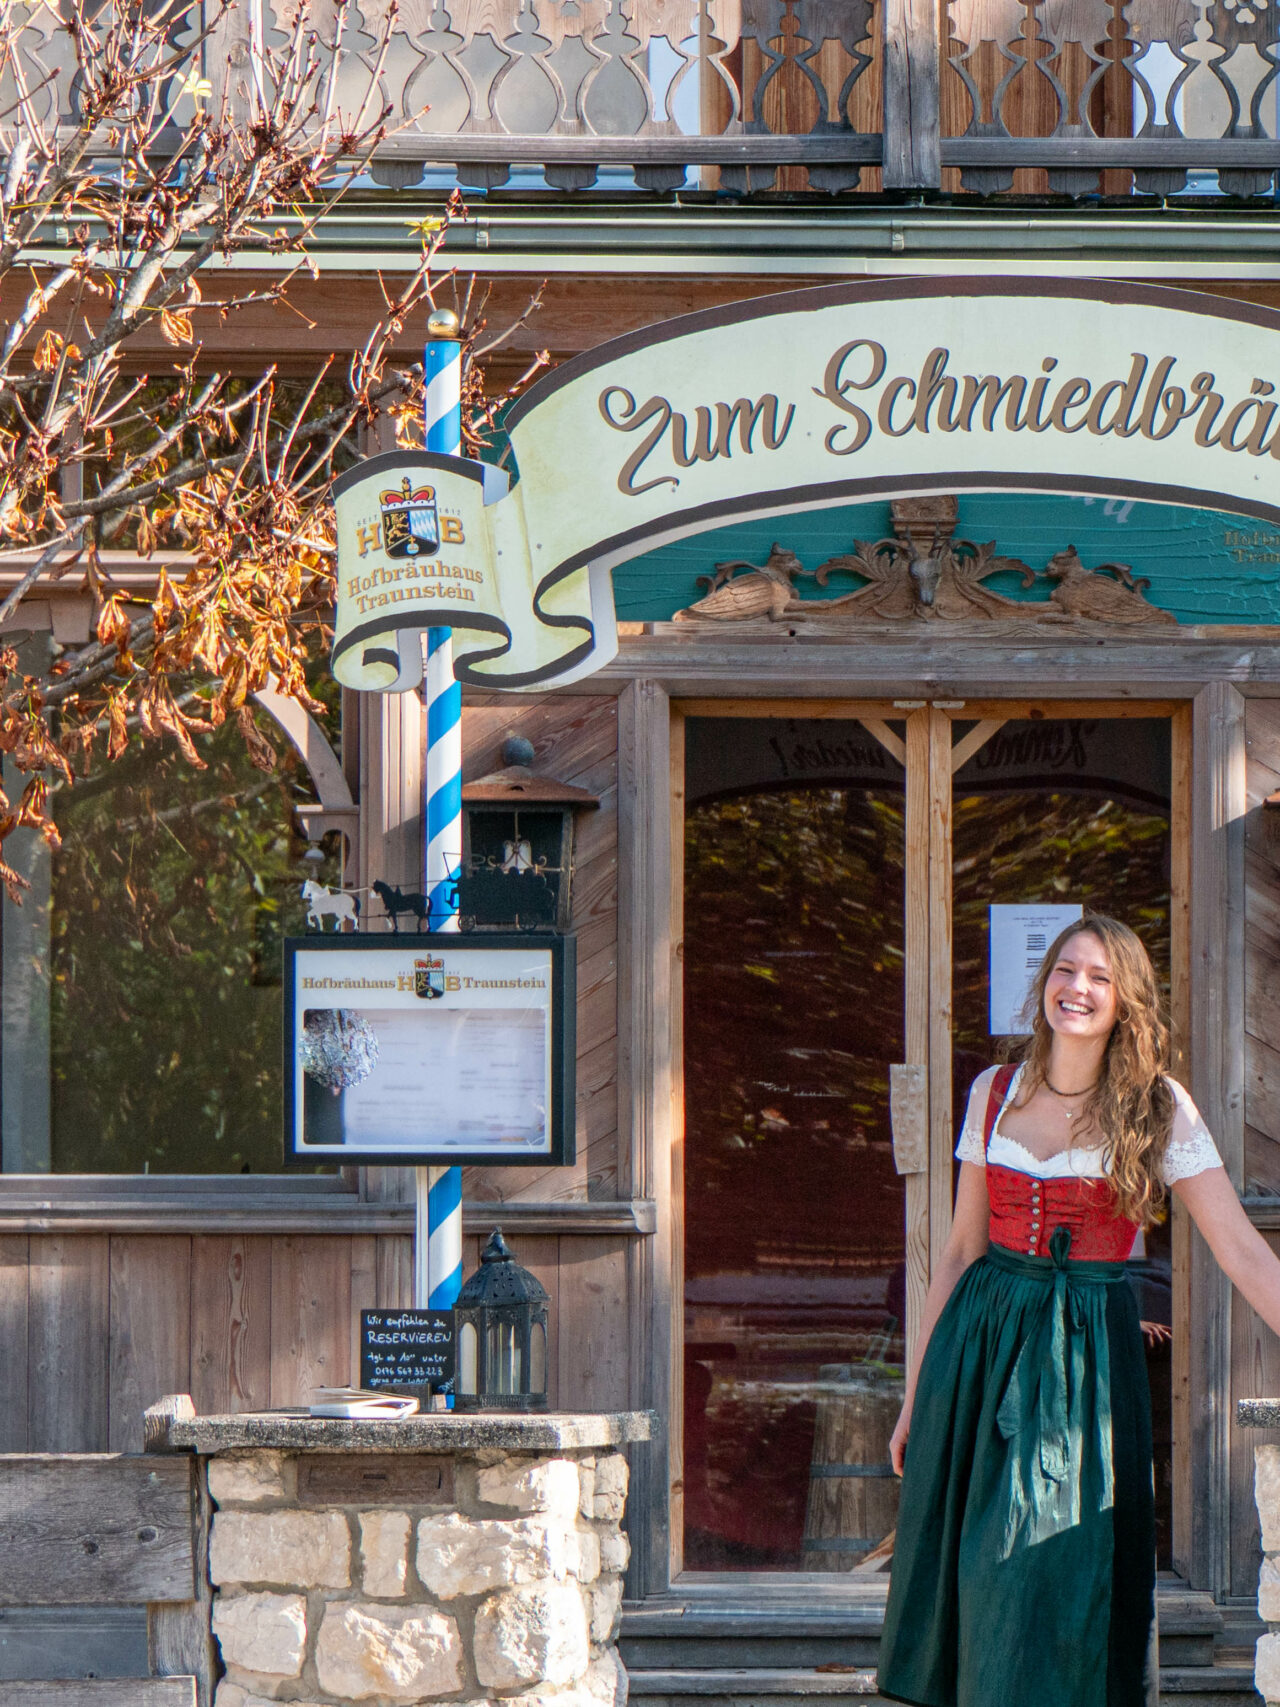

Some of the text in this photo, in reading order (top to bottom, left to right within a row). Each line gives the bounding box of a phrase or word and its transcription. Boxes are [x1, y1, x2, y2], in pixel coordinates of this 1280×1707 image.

[599, 384, 797, 496] Zum
[356, 516, 465, 557] H B
[347, 560, 483, 599] Hofbräuhaus
[356, 581, 476, 615] Traunstein
[301, 976, 396, 990] Hofbräuhaus
[463, 976, 546, 989] Traunstein
[367, 1314, 382, 1326] Wir
[386, 1313, 429, 1328] empfehlen
[422, 1354, 447, 1363] unter
